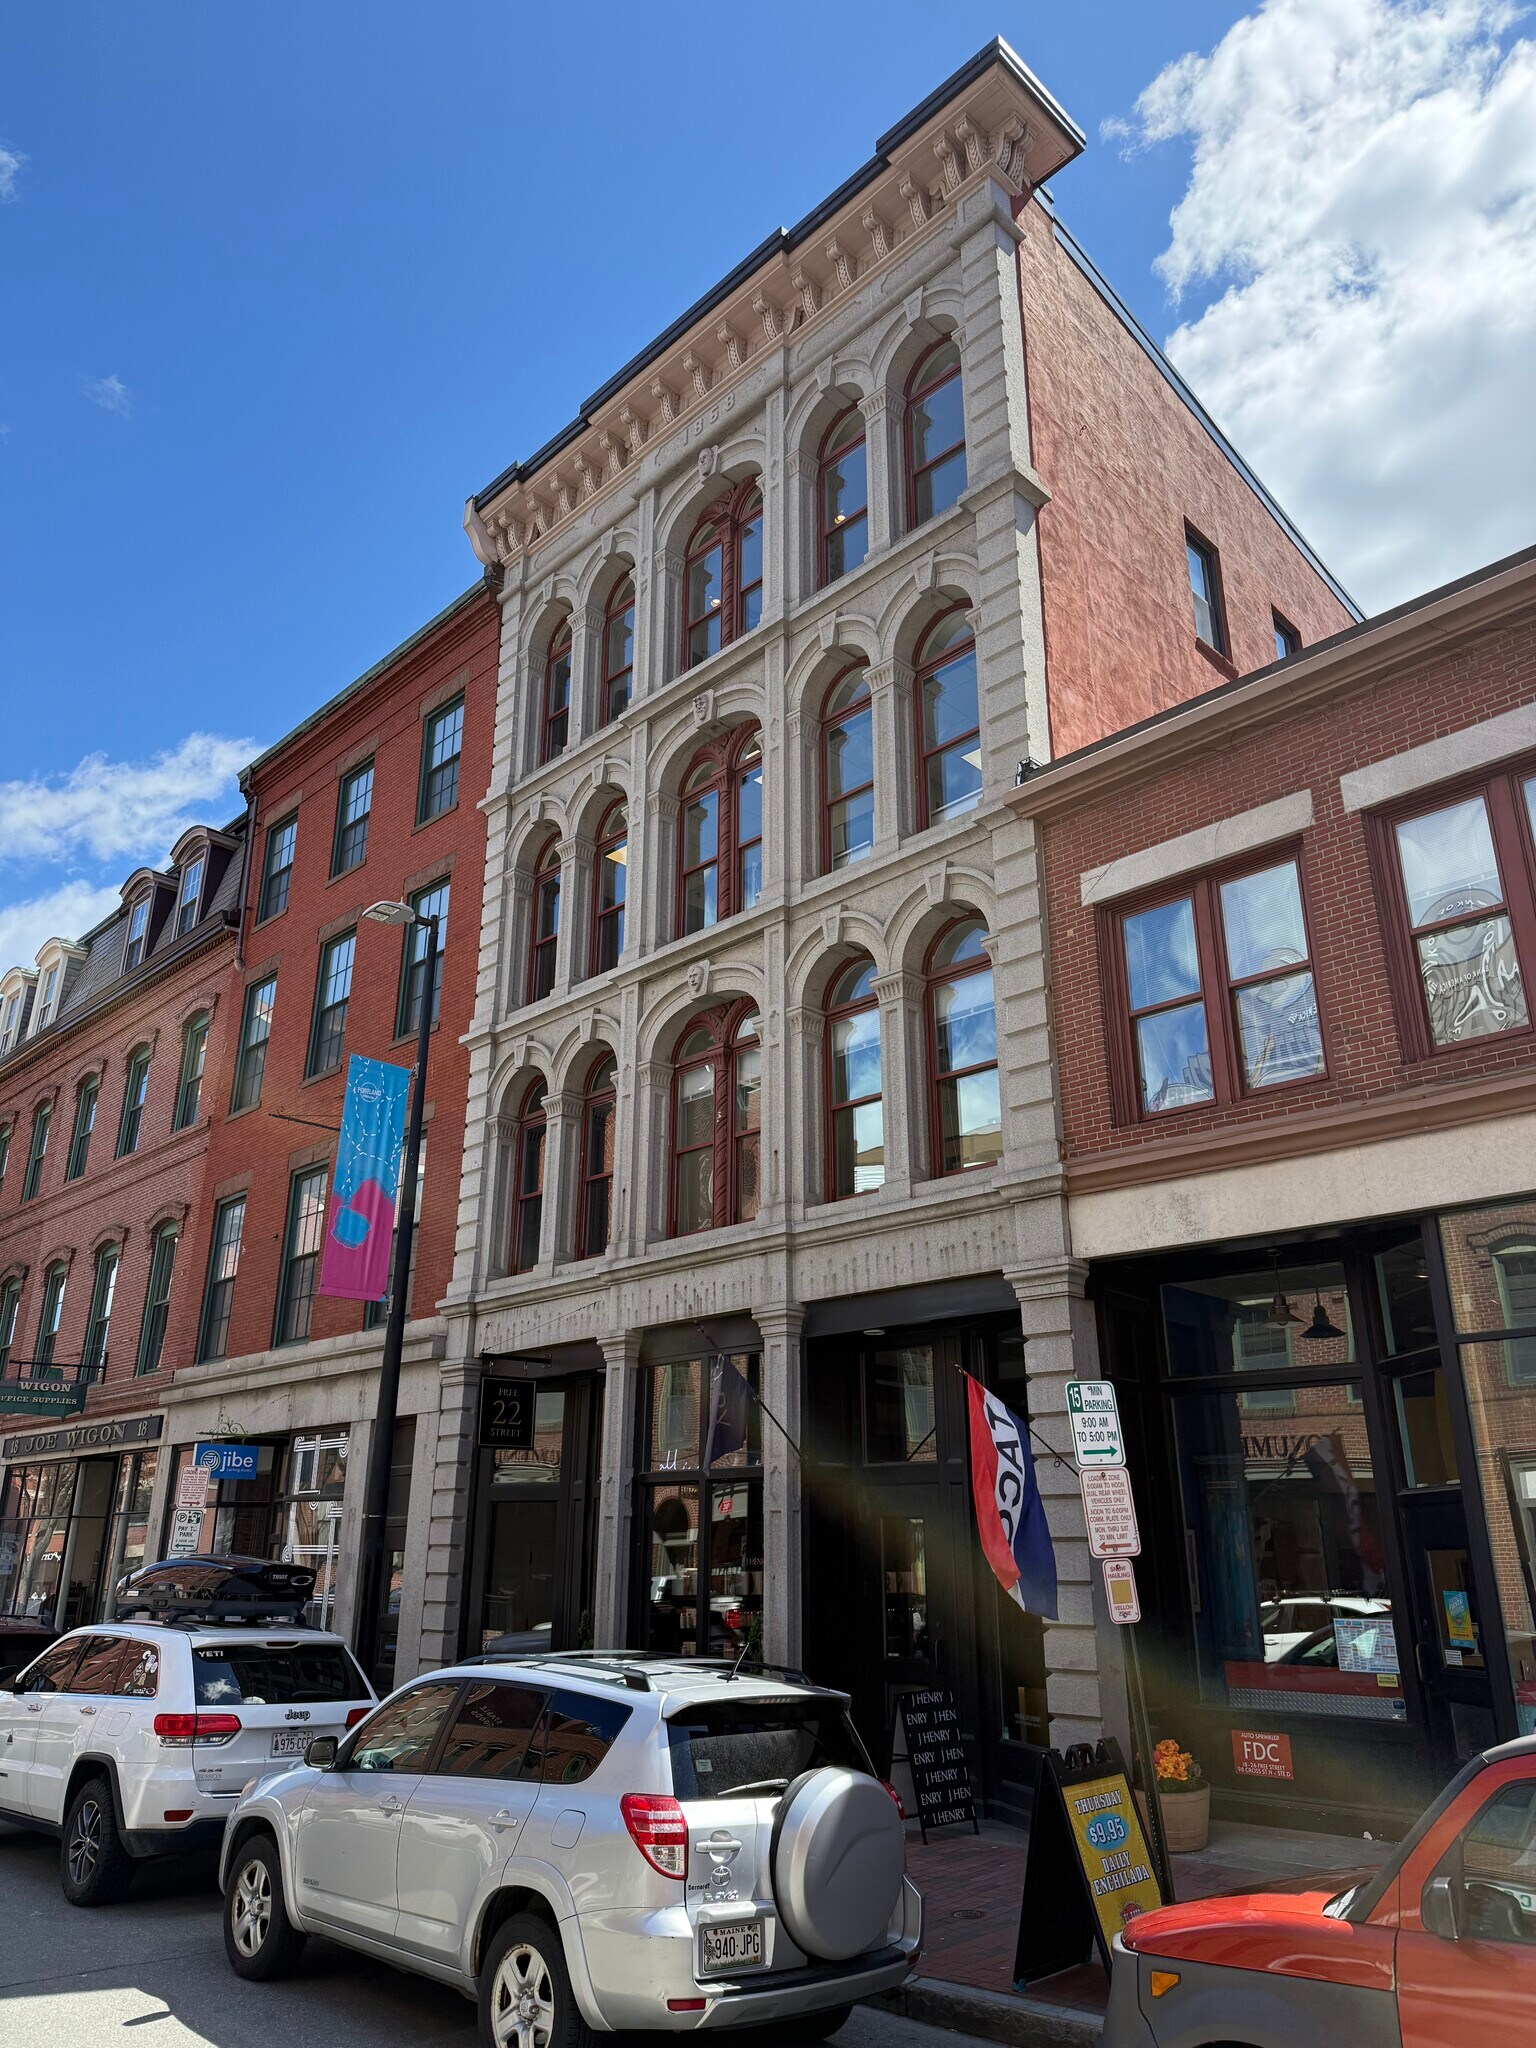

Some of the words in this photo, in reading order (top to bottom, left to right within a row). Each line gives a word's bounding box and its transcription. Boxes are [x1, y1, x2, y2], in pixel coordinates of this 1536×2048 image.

[19, 1381, 72, 1393] WIGON
[499, 1387, 519, 1397] FREE
[0, 1395, 29, 1403] FFICE
[32, 1396, 78, 1405] SUPPLIES
[1069, 1387, 1081, 1408] 15
[1090, 1386, 1103, 1396] MIN
[1084, 1399, 1113, 1410] PARKING
[493, 1400, 522, 1425] 22
[1081, 1417, 1097, 1428] 9:00
[1098, 1416, 1109, 1428] AM
[10, 1439, 19, 1454] 18
[24, 1433, 58, 1451] JOE
[66, 1423, 127, 1447] WIGON
[137, 1420, 148, 1437] 18
[490, 1427, 522, 1437] STREET
[1077, 1431, 1087, 1442] TO
[1089, 1431, 1105, 1442] 5:00
[1106, 1430, 1118, 1441] PM
[219, 1451, 254, 1473] jibe
[1098, 1489, 1111, 1497] REAR
[198, 1650, 224, 1658] YETI
[911, 1694, 915, 1707] J
[916, 1691, 944, 1705] HENRY
[284, 1709, 311, 1721] Jeep
[906, 1712, 928, 1725] ENRY
[938, 1709, 957, 1722] HEN
[918, 1733, 922, 1746] J
[922, 1729, 950, 1744] HENRY
[1255, 1733, 1280, 1741] SPRINKLER
[913, 1751, 935, 1765] ENRY
[946, 1747, 964, 1760] HEN
[1243, 1741, 1280, 1763] FDC
[925, 1772, 929, 1786] J
[930, 1768, 958, 1784] HENRY
[920, 1791, 942, 1805] ENRY
[953, 1787, 972, 1800] HEN
[1074, 1788, 1123, 1815] THURSDAY
[937, 1808, 966, 1824] HENRY
[1088, 1817, 1126, 1846] $9.95
[1101, 1851, 1132, 1874] DAILY
[1092, 1864, 1151, 1896] ENCHILADA
[719, 1926, 746, 1936] MAINE
